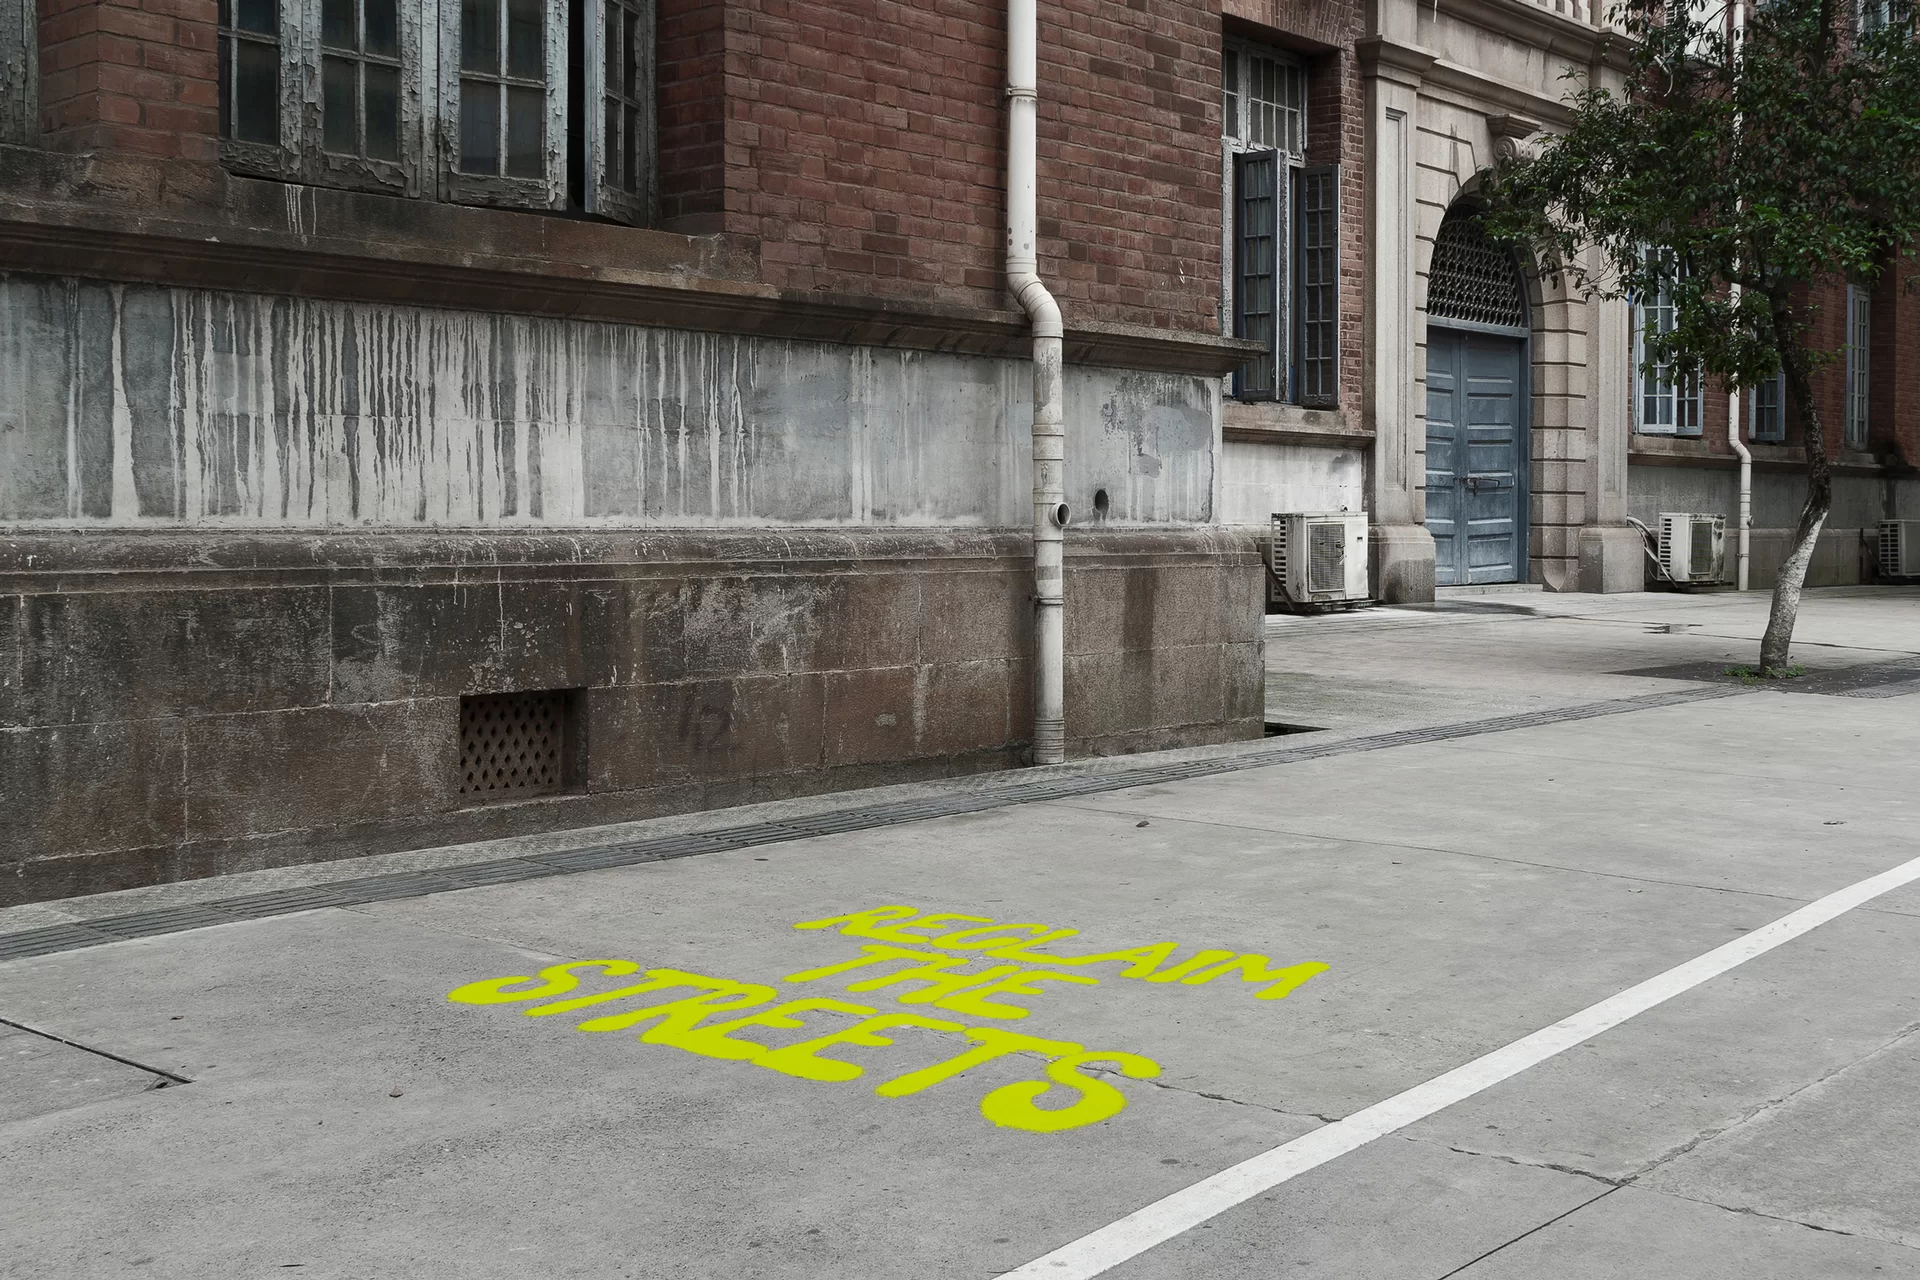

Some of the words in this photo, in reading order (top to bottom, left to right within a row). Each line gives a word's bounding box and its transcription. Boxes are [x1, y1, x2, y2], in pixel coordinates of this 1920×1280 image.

[783, 944, 1099, 1020] THE
[794, 906, 1330, 1000] RECLAIM
[447, 960, 1161, 1133] STREETS
